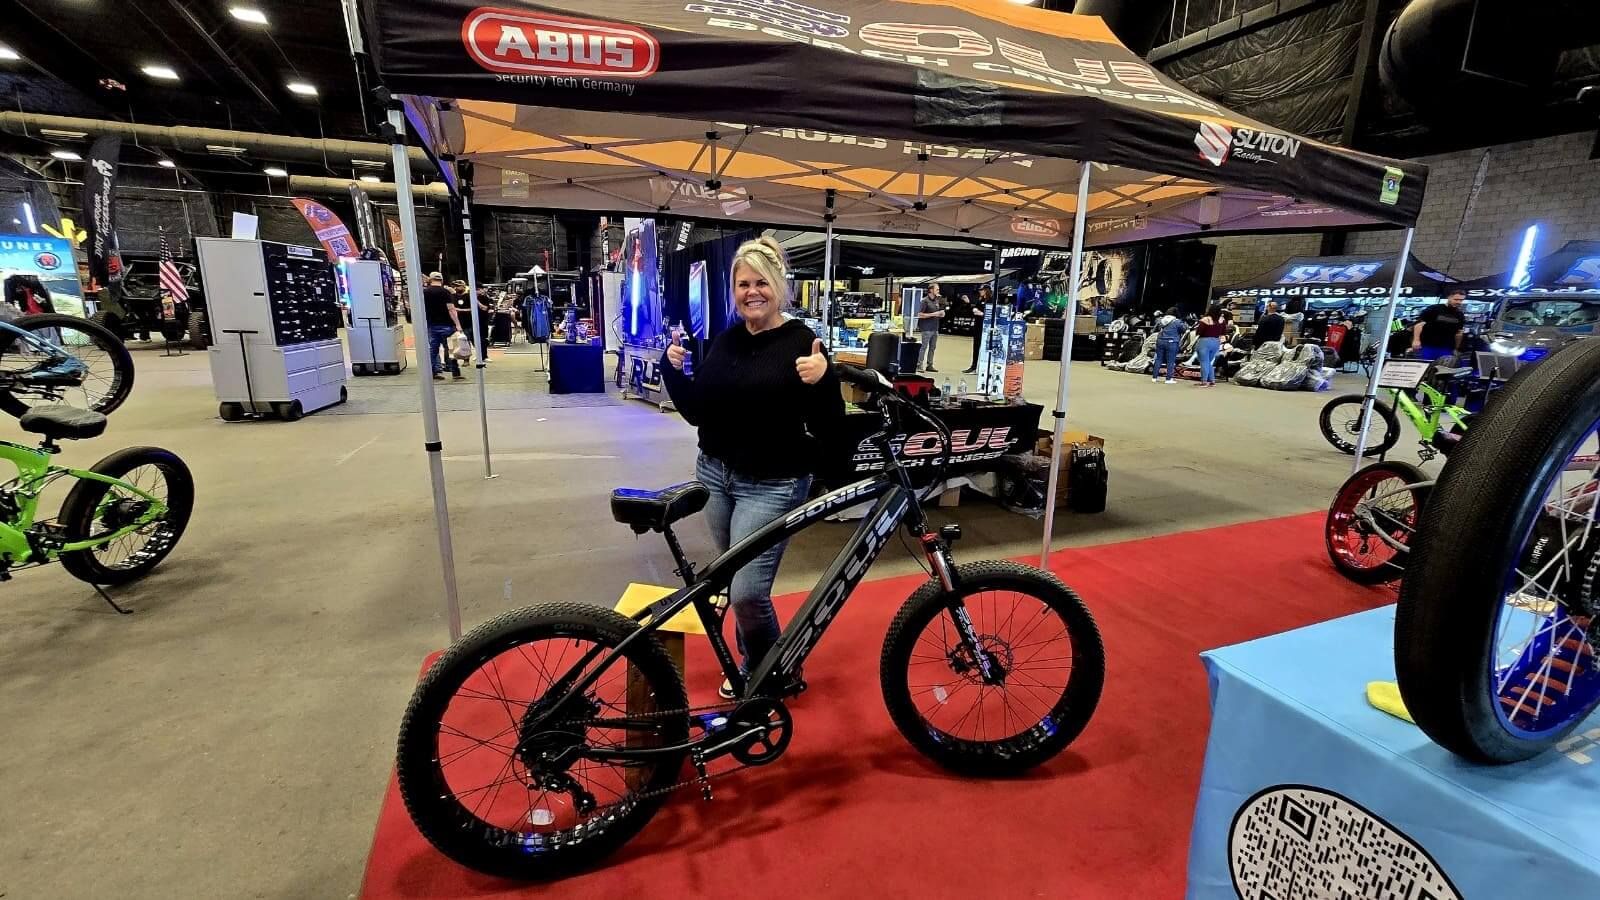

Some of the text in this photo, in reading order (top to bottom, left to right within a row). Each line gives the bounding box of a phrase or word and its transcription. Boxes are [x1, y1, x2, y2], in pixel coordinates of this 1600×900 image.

[494, 25, 635, 68] ABUS
[495, 74, 636, 96] Security Tech Germany
[1231, 147, 1278, 164] Racing
[1233, 128, 1300, 159] SLATON
[852, 426, 1019, 461] SOUL
[855, 458, 926, 472] BECH
[785, 479, 877, 530] SONIC
[779, 498, 910, 675] SOUL
